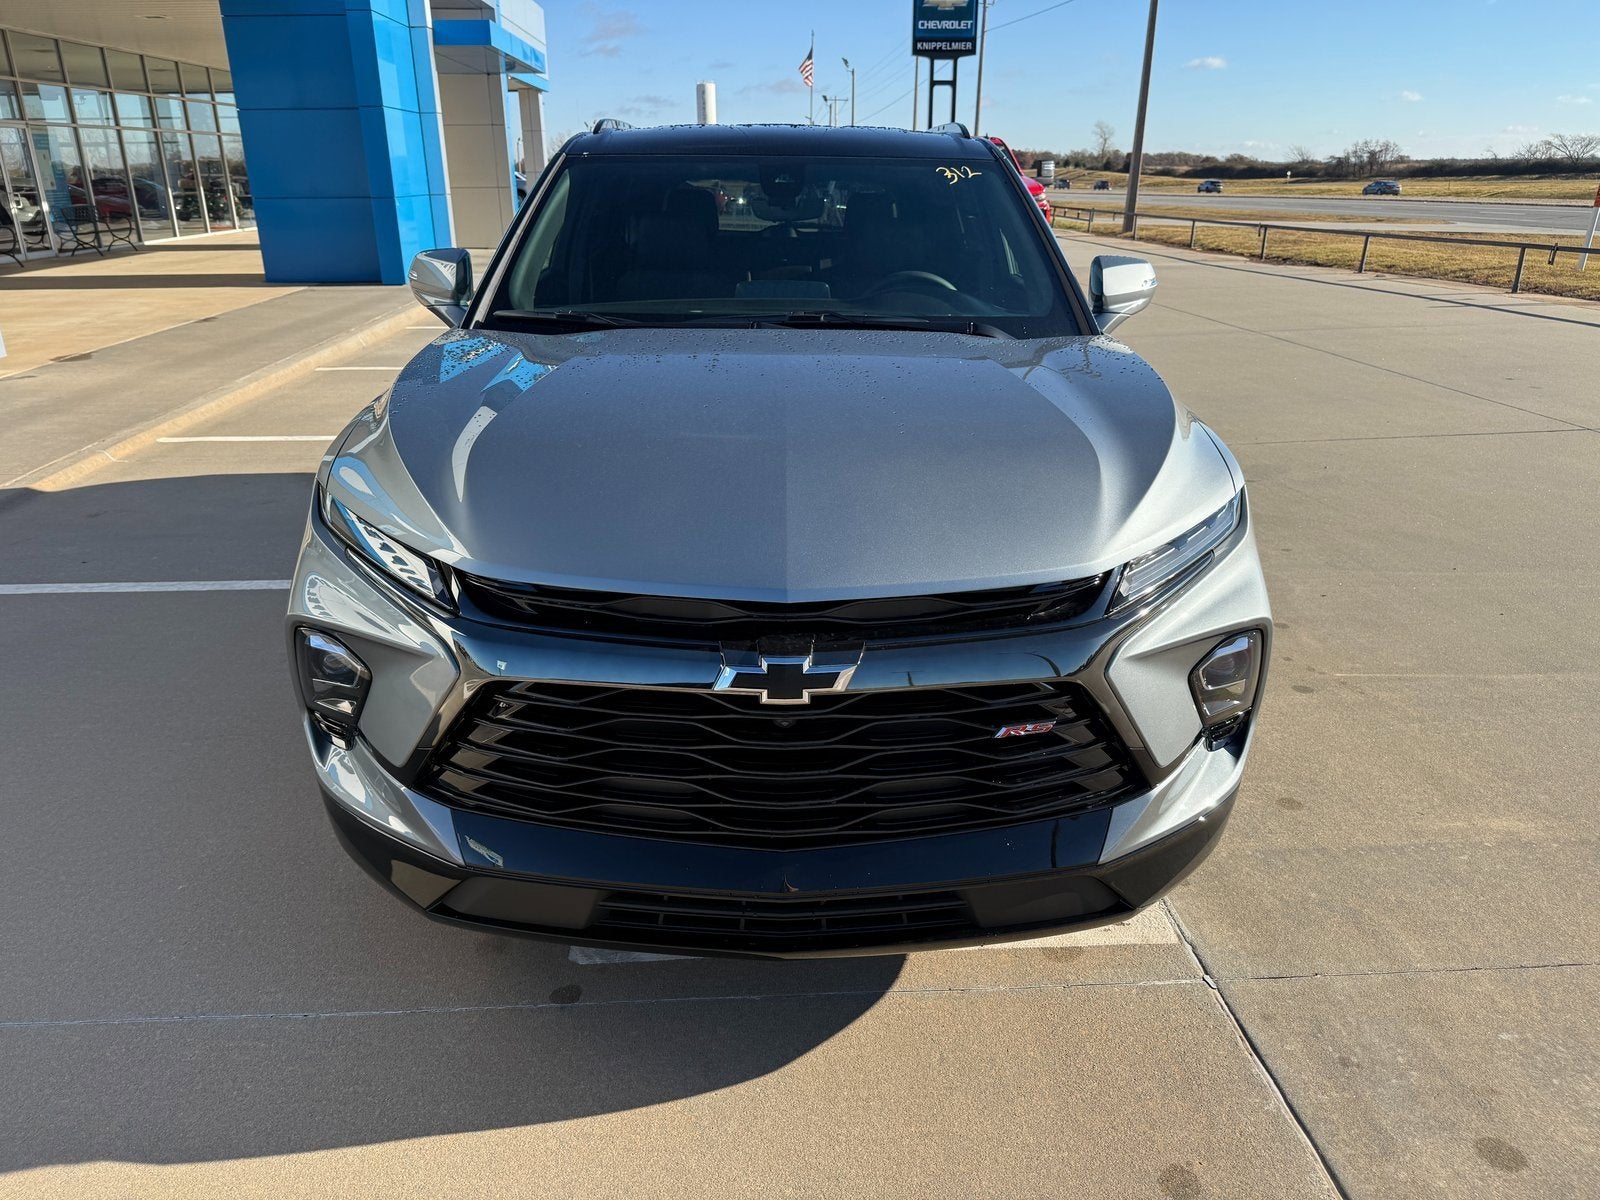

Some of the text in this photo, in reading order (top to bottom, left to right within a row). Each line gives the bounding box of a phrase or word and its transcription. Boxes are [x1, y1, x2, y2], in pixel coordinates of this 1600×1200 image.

[918, 20, 973, 30] CHEVROLET
[916, 42, 972, 50] KNIPPELMIER
[935, 165, 982, 185] 312
[994, 720, 1057, 738] RS
